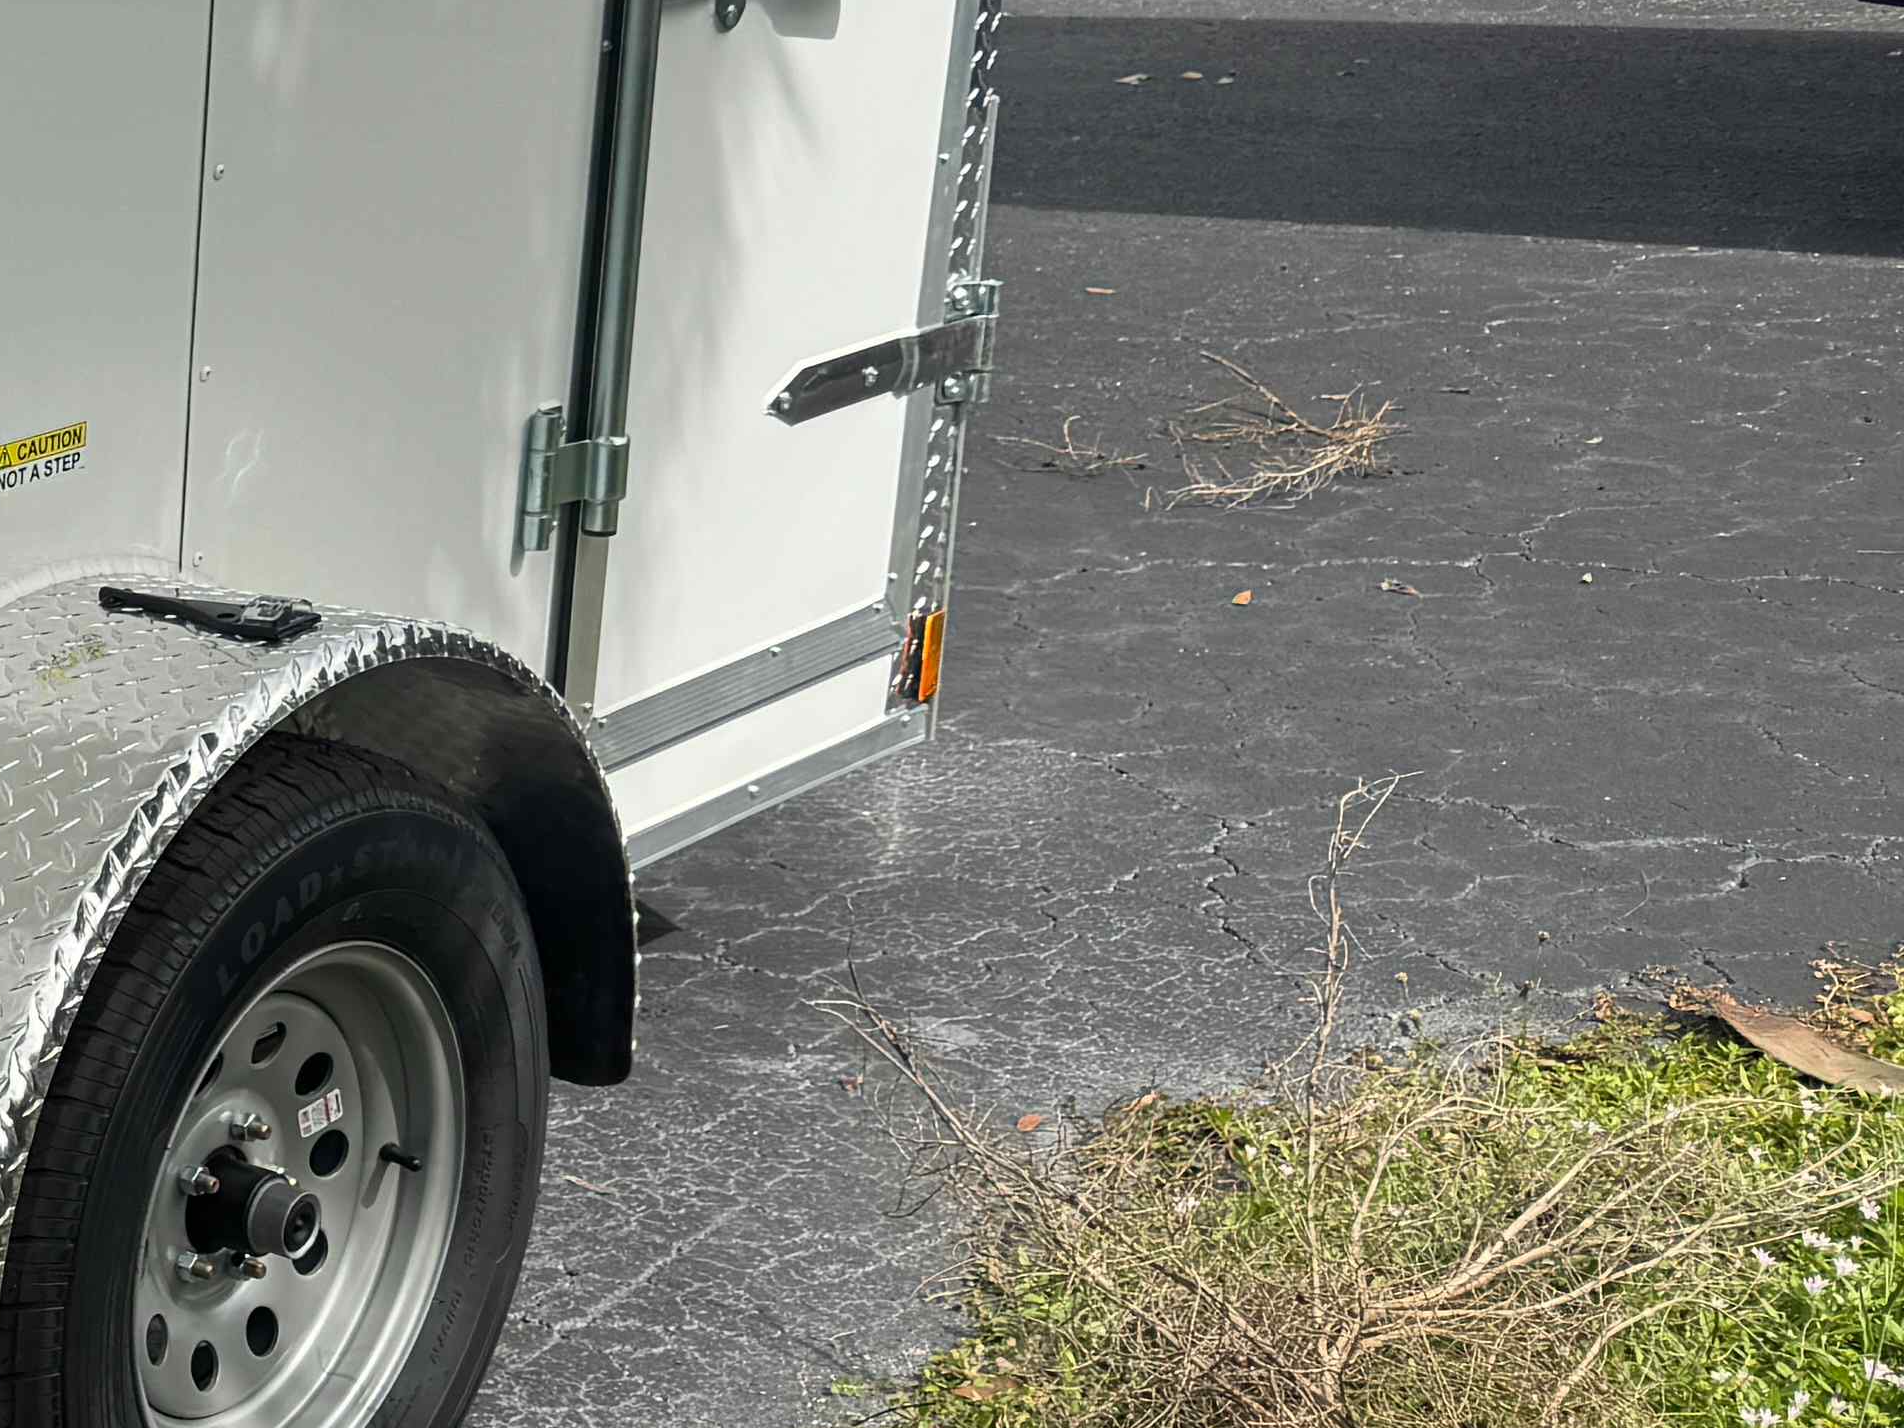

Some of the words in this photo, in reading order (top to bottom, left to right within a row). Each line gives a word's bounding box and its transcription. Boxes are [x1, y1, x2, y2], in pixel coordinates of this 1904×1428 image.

[17, 425, 83, 461] CAUTION
[29, 463, 40, 483] A
[44, 451, 81, 478] STEP
[216, 871, 322, 997] LOAD
